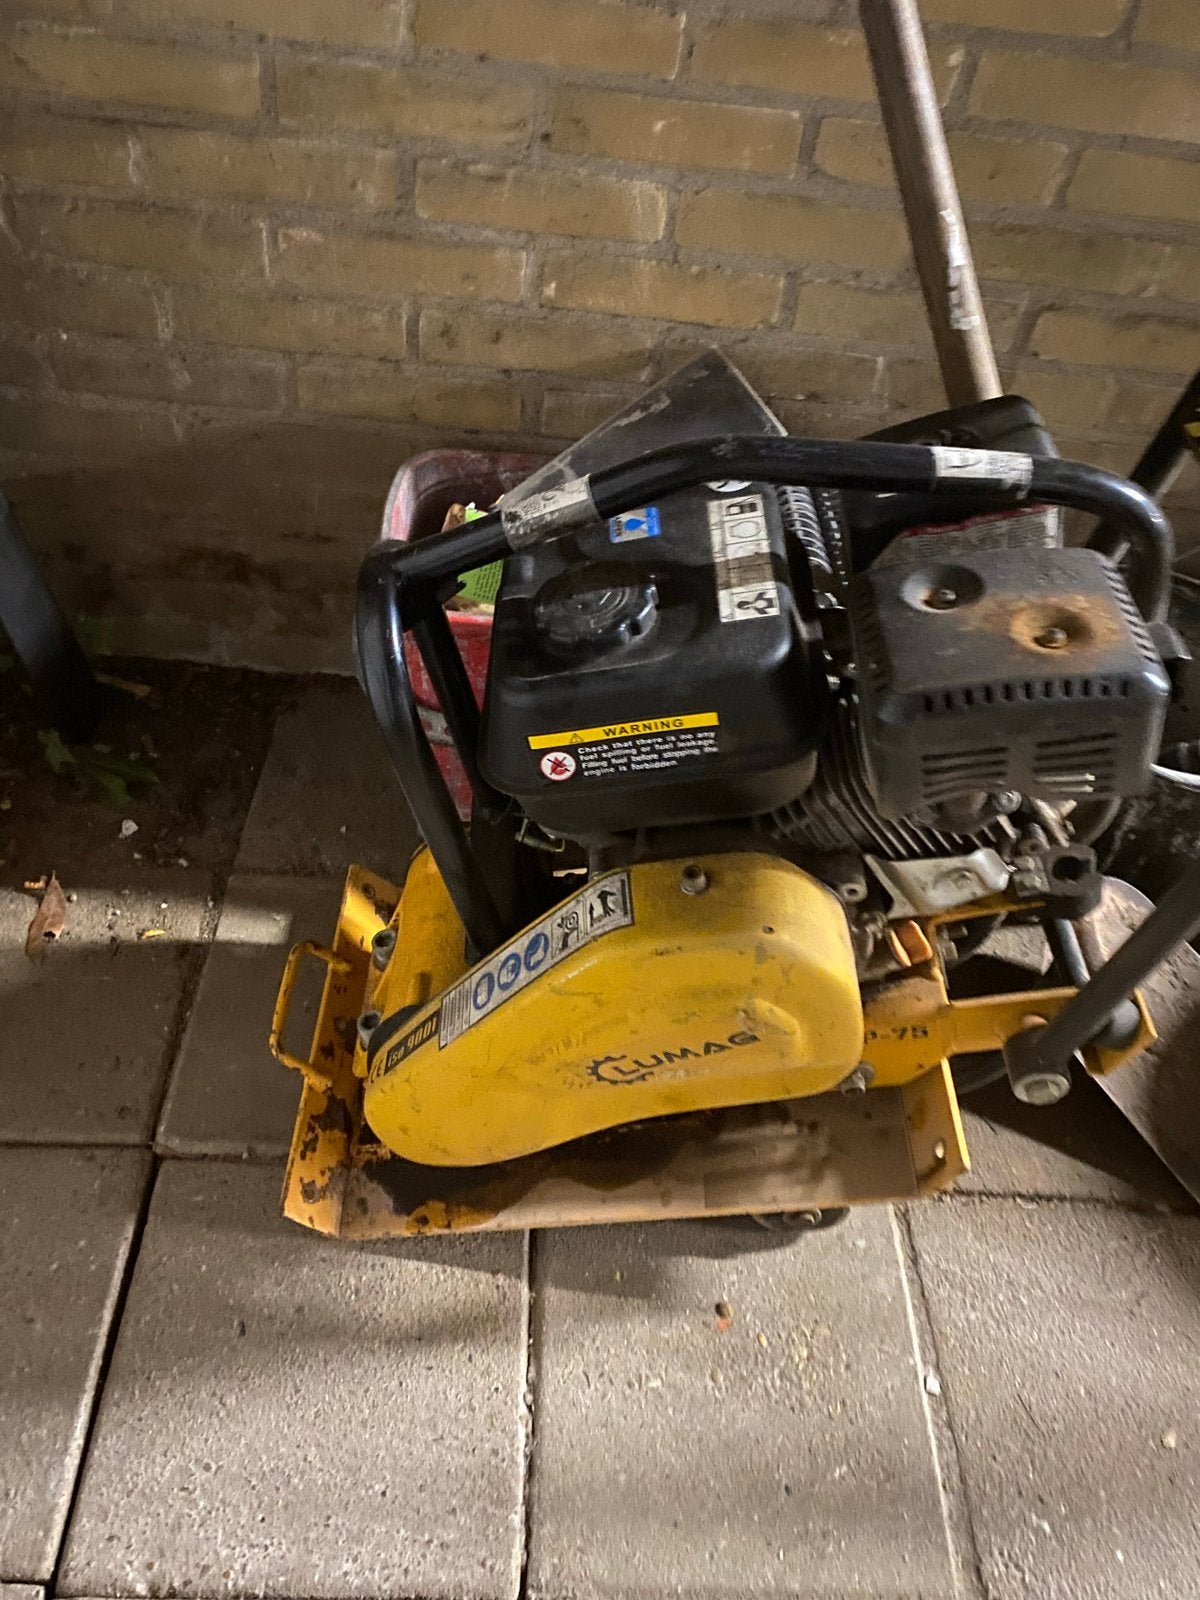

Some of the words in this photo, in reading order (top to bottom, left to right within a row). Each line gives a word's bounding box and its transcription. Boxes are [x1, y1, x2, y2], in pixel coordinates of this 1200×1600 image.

[602, 718, 684, 737] WARNING
[577, 744, 609, 754] Check
[611, 740, 633, 749] that
[635, 736, 663, 746] there
[696, 731, 716, 739] any
[579, 752, 598, 761] fuel
[601, 748, 638, 758] spilling
[653, 742, 674, 750] fuel
[581, 760, 608, 769] Filling
[611, 756, 628, 764] fuel
[630, 753, 659, 762] before
[662, 748, 701, 759] stopping
[583, 767, 615, 777] engine
[618, 764, 628, 772] is
[631, 760, 678, 770] forbidden
[407, 1016, 437, 1050] 9001
[613, 1031, 761, 1075] LUMAG
